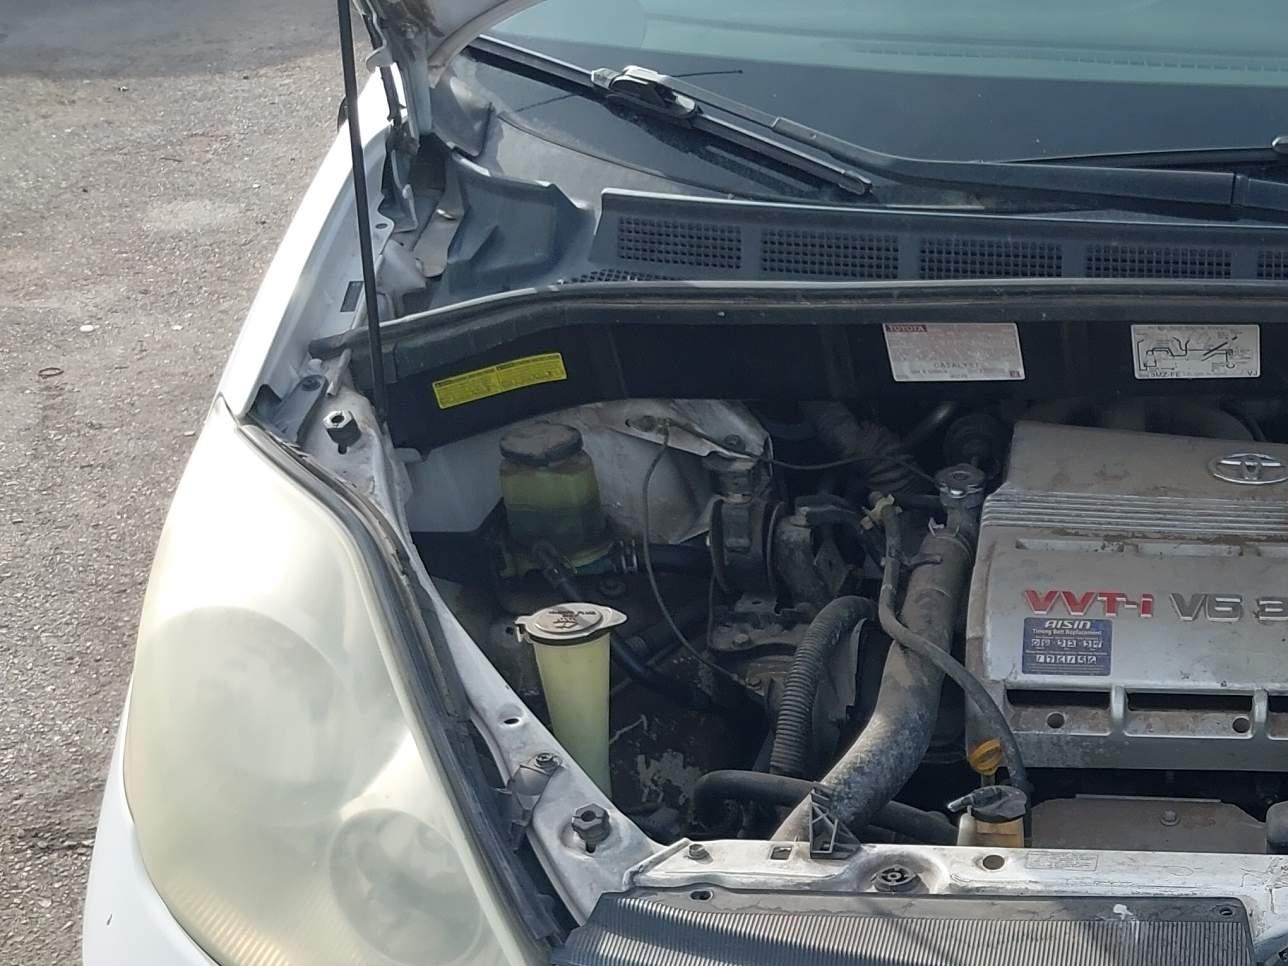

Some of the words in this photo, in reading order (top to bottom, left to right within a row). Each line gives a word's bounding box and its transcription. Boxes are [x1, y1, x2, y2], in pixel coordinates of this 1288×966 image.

[1024, 589, 1154, 619] VVT-i
[1169, 593, 1243, 622] V6
[1045, 619, 1091, 629] AISIN
[1032, 628, 1051, 636] Timing
